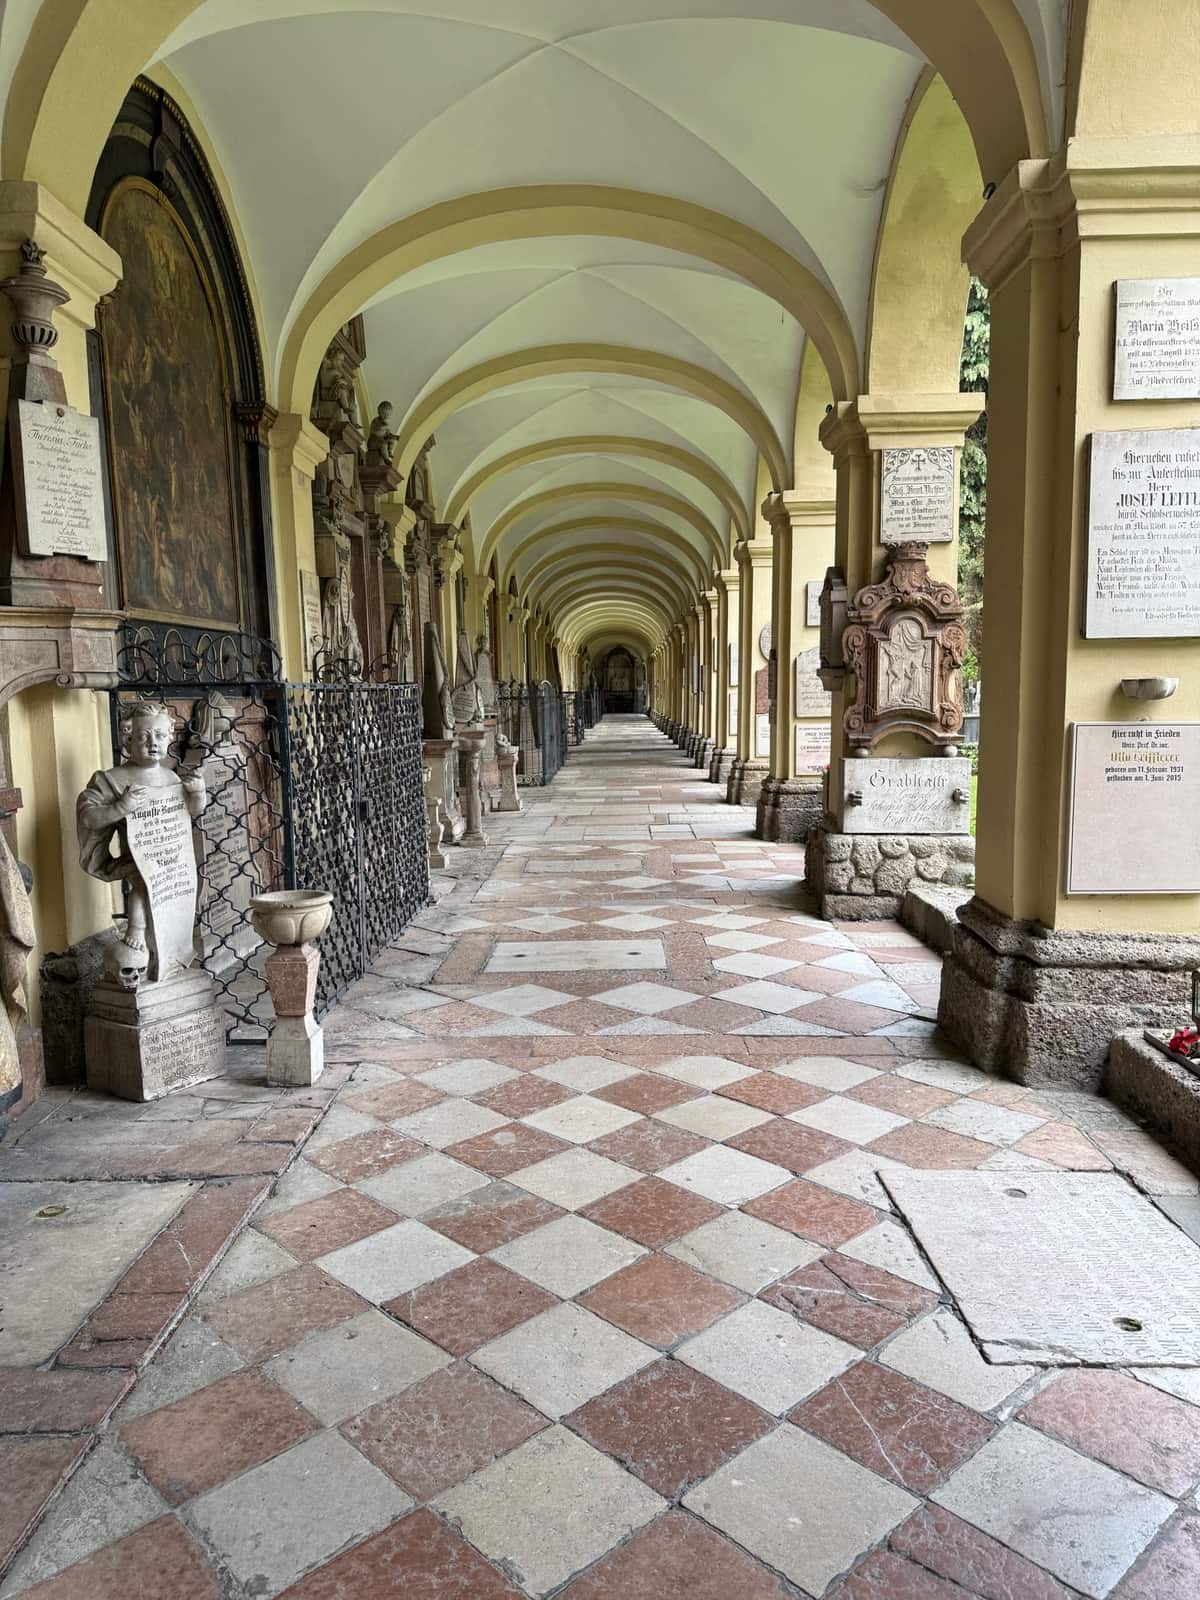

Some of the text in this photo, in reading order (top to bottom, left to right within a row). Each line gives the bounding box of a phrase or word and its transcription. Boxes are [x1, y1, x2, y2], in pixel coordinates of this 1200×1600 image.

[1127, 319, 1165, 336] Maria
[1146, 465, 1200, 481] Auferstehun
[1148, 482, 1173, 492] Herr
[1116, 493, 1158, 507] JOSEF
[1111, 729, 1181, 739] Hier ruht in Frieden
[1166, 774, 1181, 782] 2015
